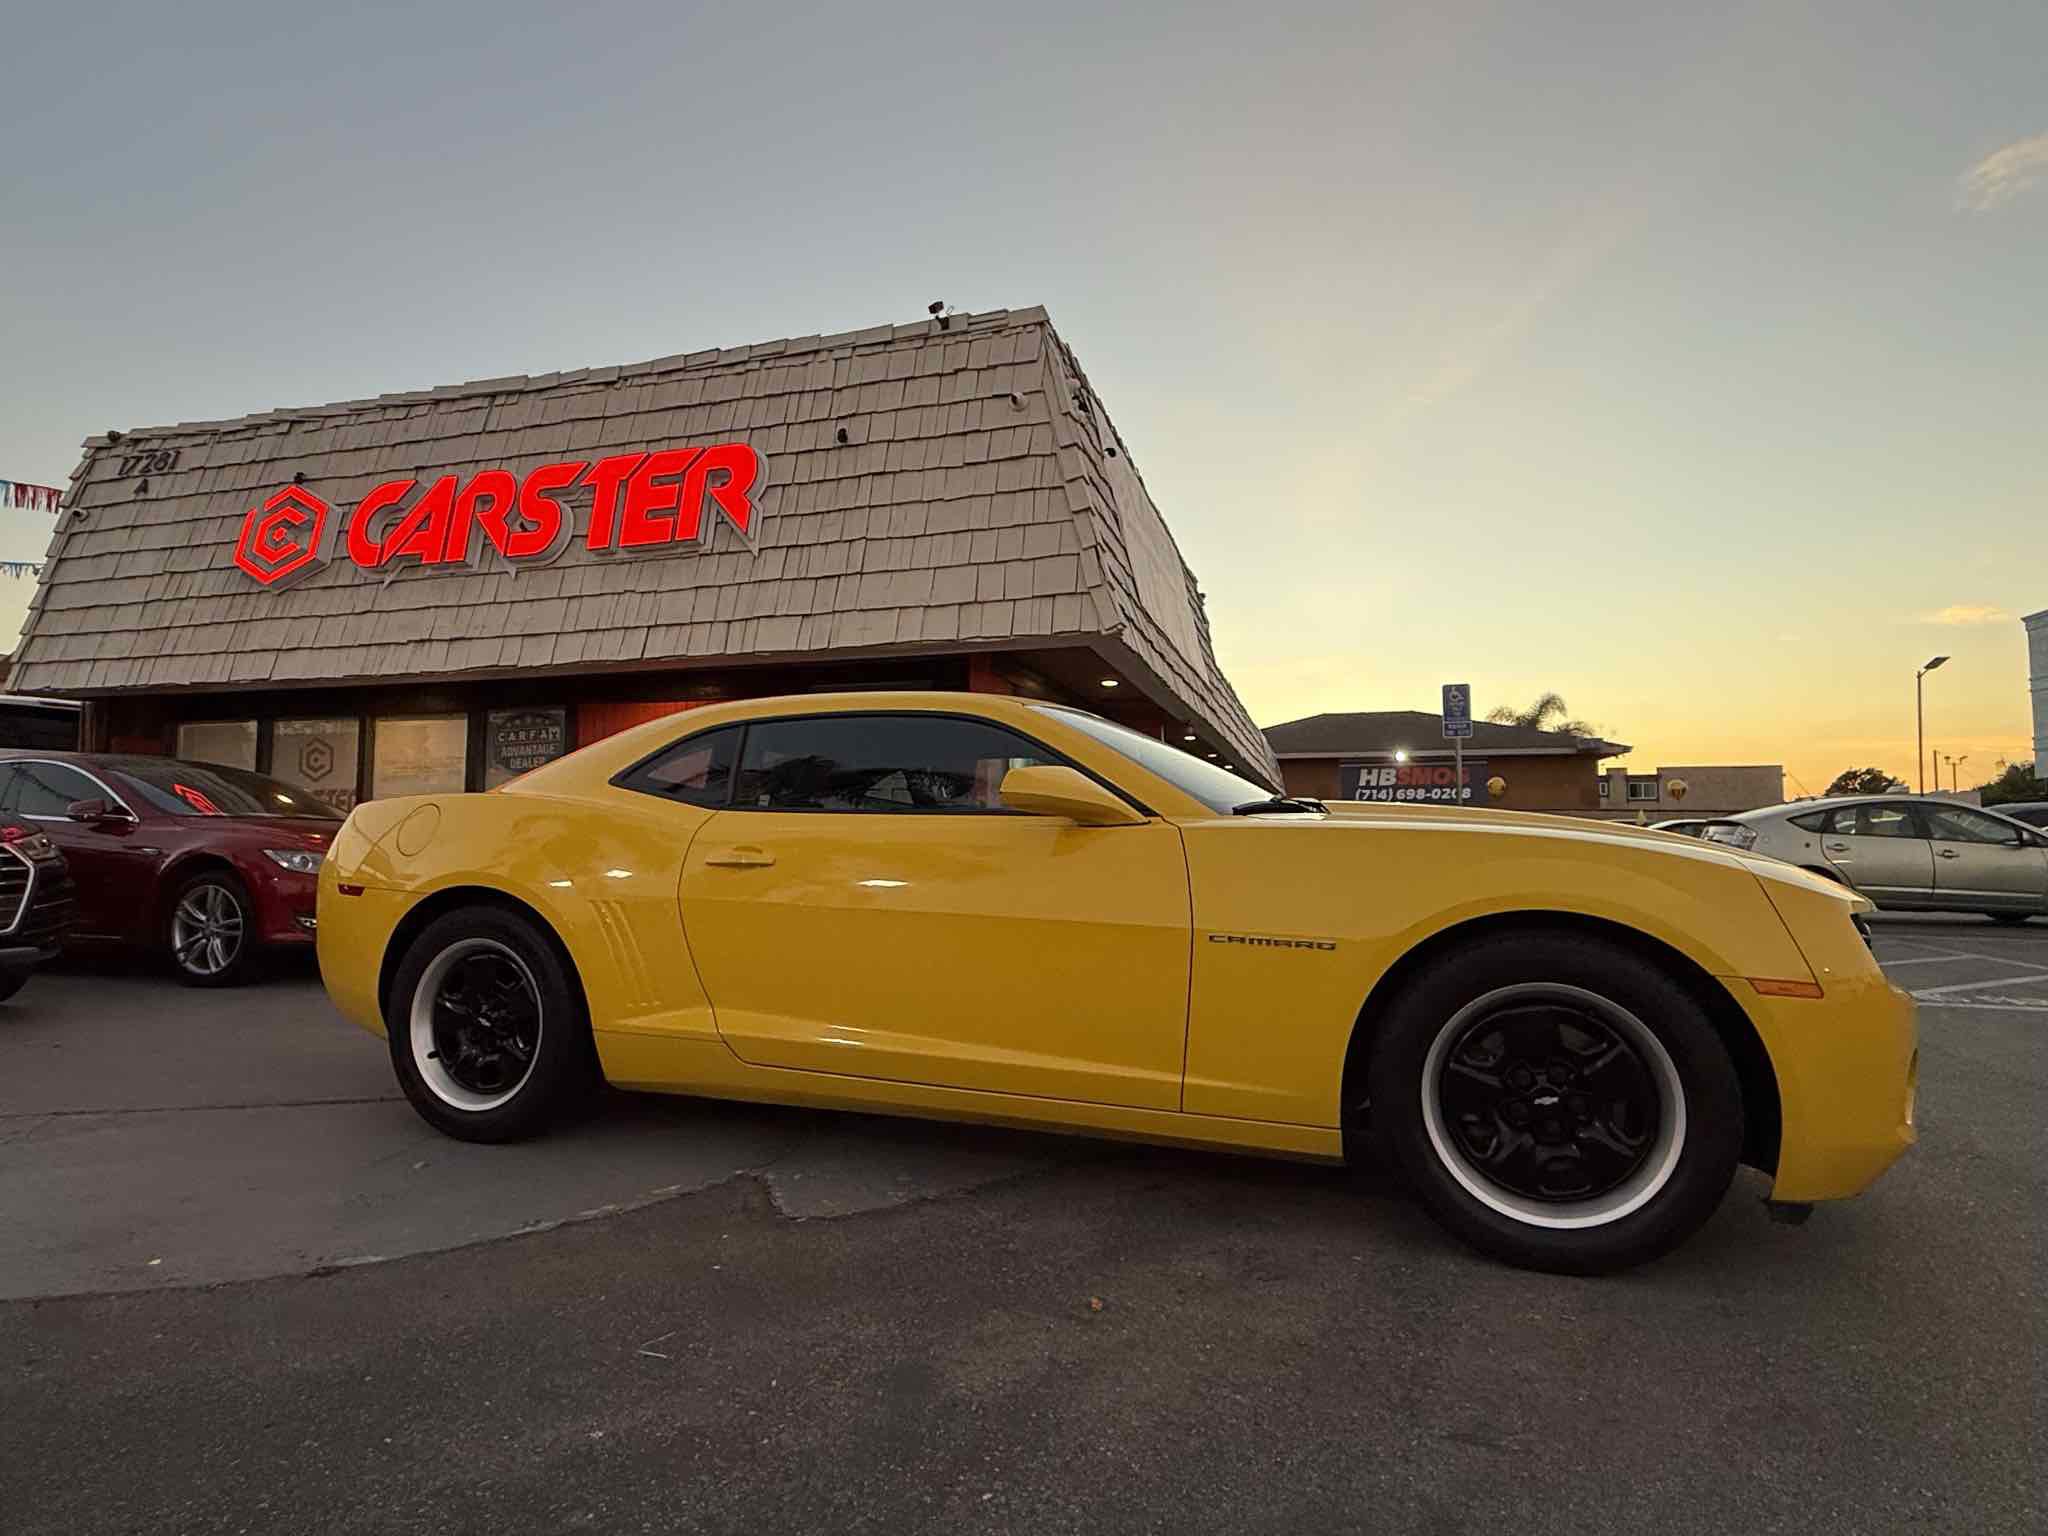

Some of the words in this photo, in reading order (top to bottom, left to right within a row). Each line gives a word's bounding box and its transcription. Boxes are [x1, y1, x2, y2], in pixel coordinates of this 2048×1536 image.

[346, 442, 760, 570] CARSTER
[1355, 788, 1394, 800] (714)
[1208, 935, 1337, 950] CAMARO
